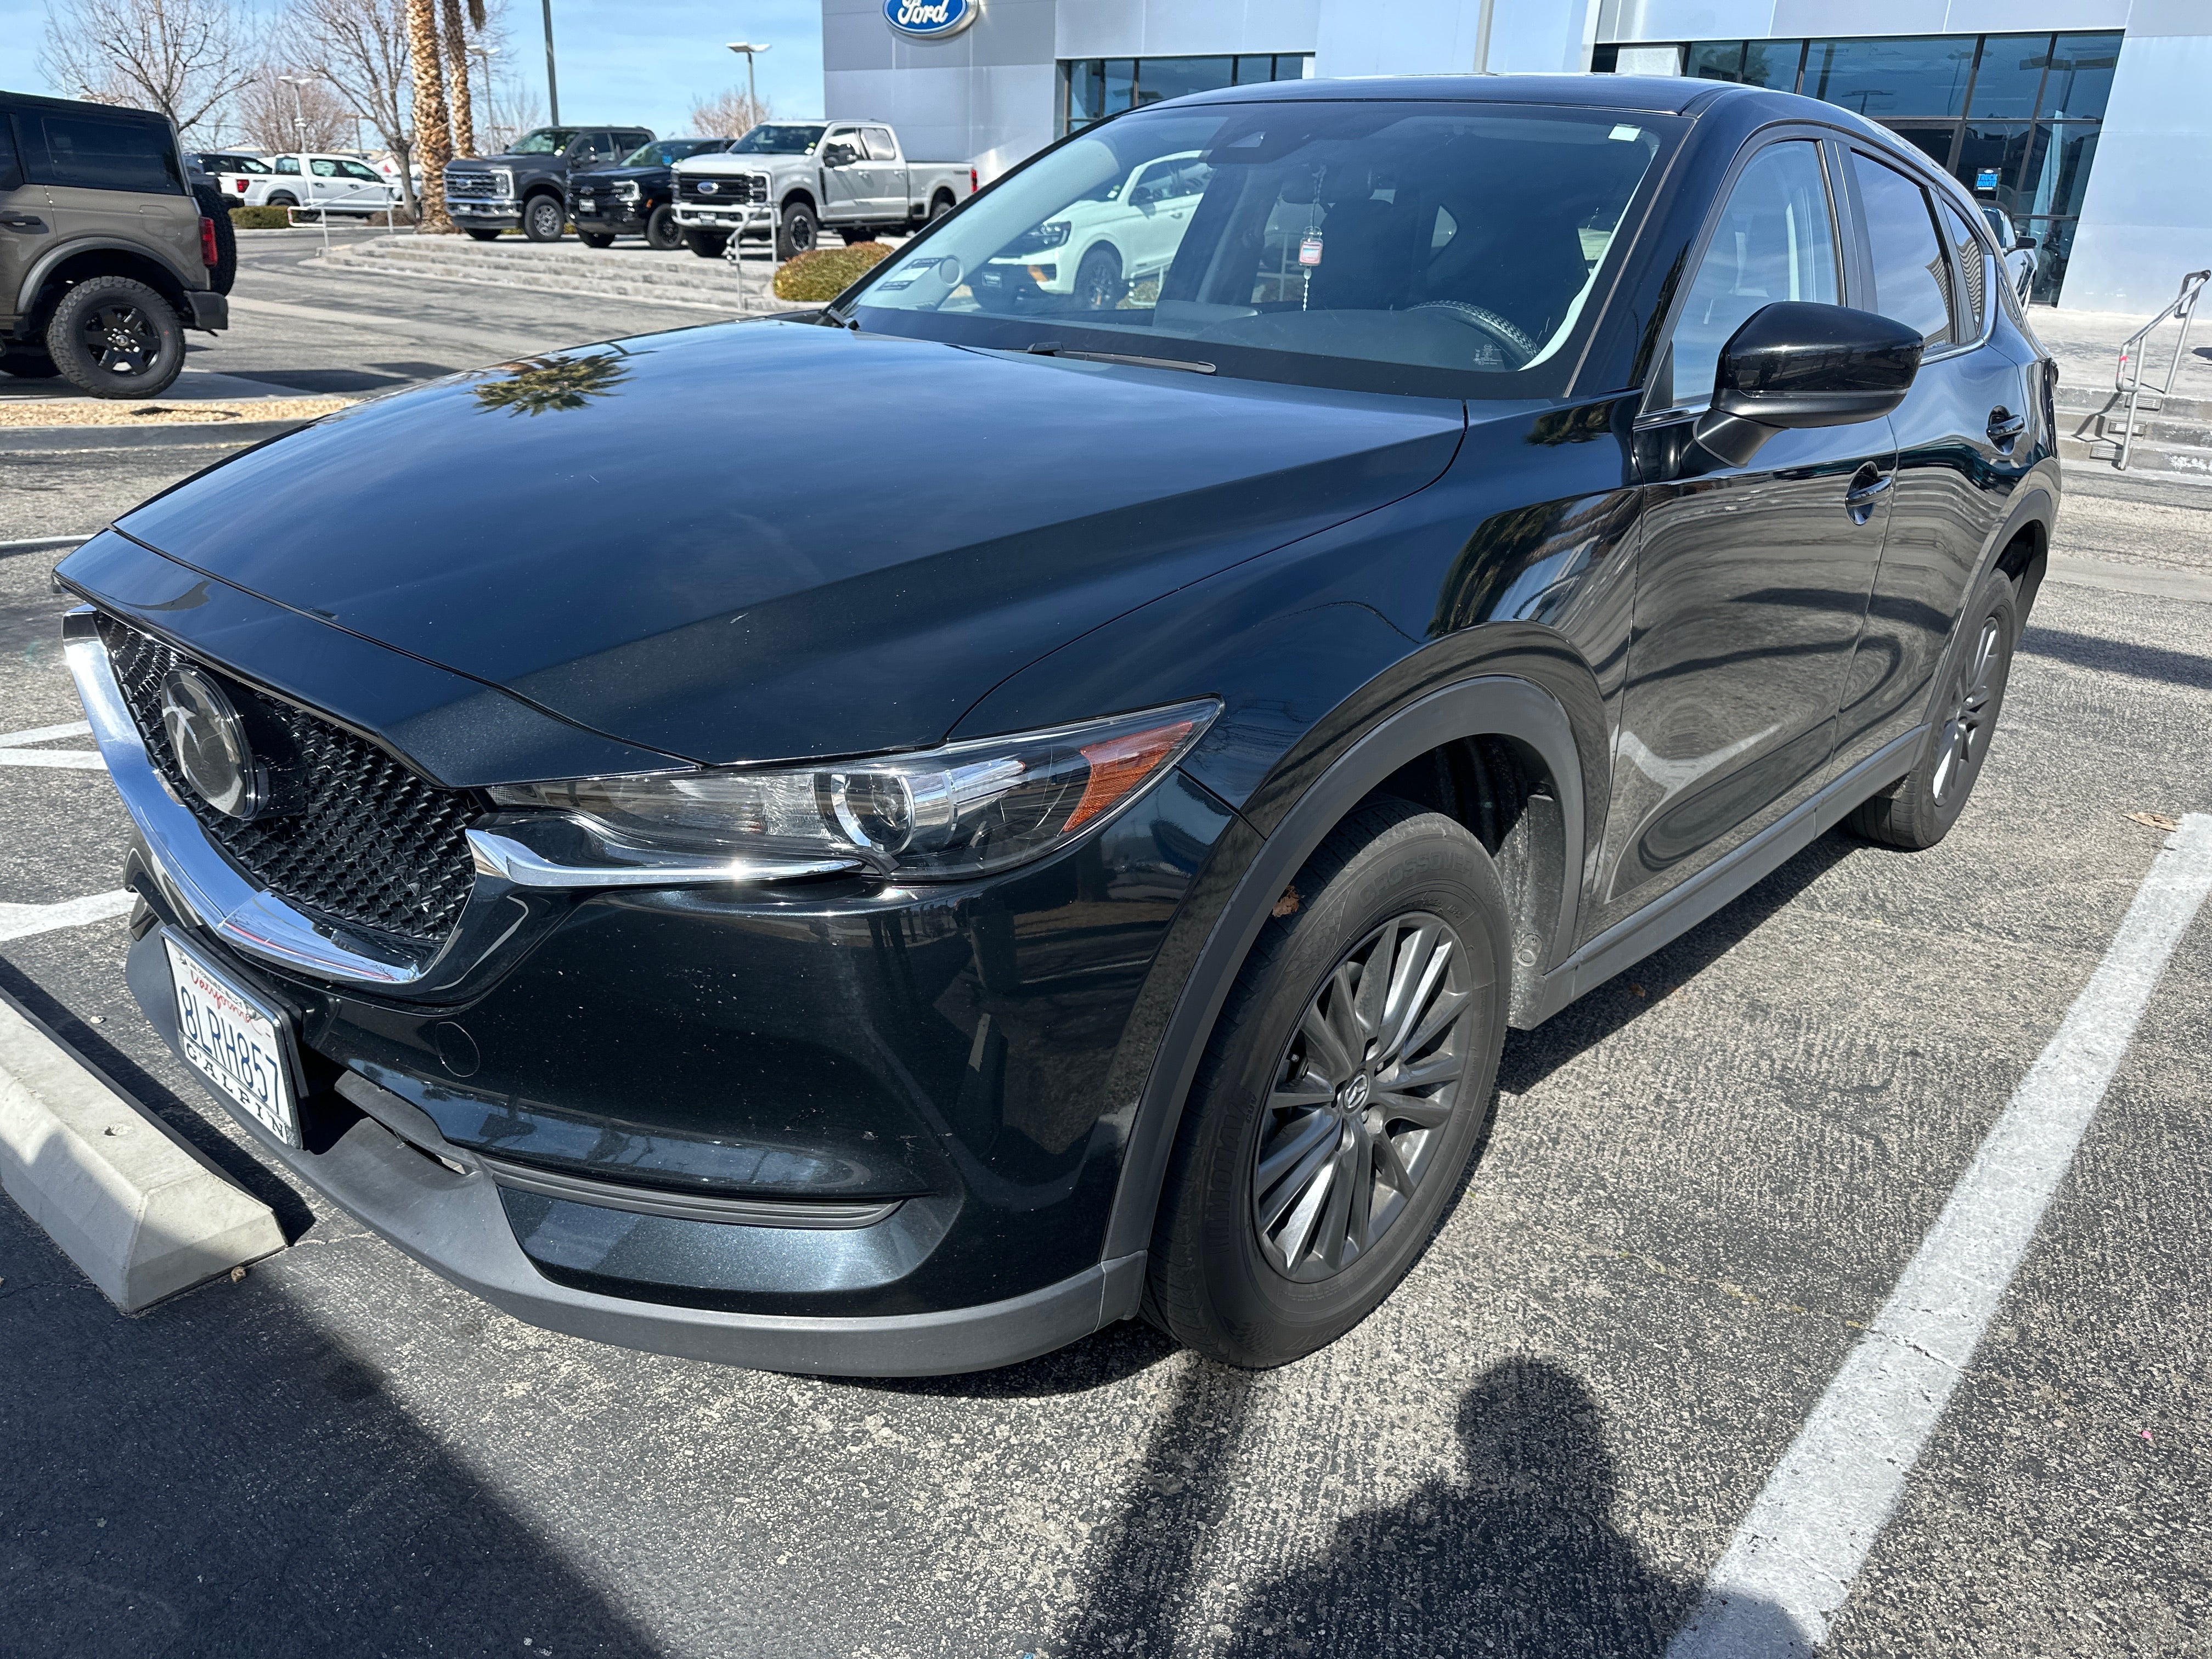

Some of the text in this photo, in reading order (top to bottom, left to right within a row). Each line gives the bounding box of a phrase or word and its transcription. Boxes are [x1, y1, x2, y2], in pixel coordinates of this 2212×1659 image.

[897, 0, 949, 24] Ford
[181, 985, 280, 1115] 8LRH857
[187, 1043, 284, 1138] GALPIN
